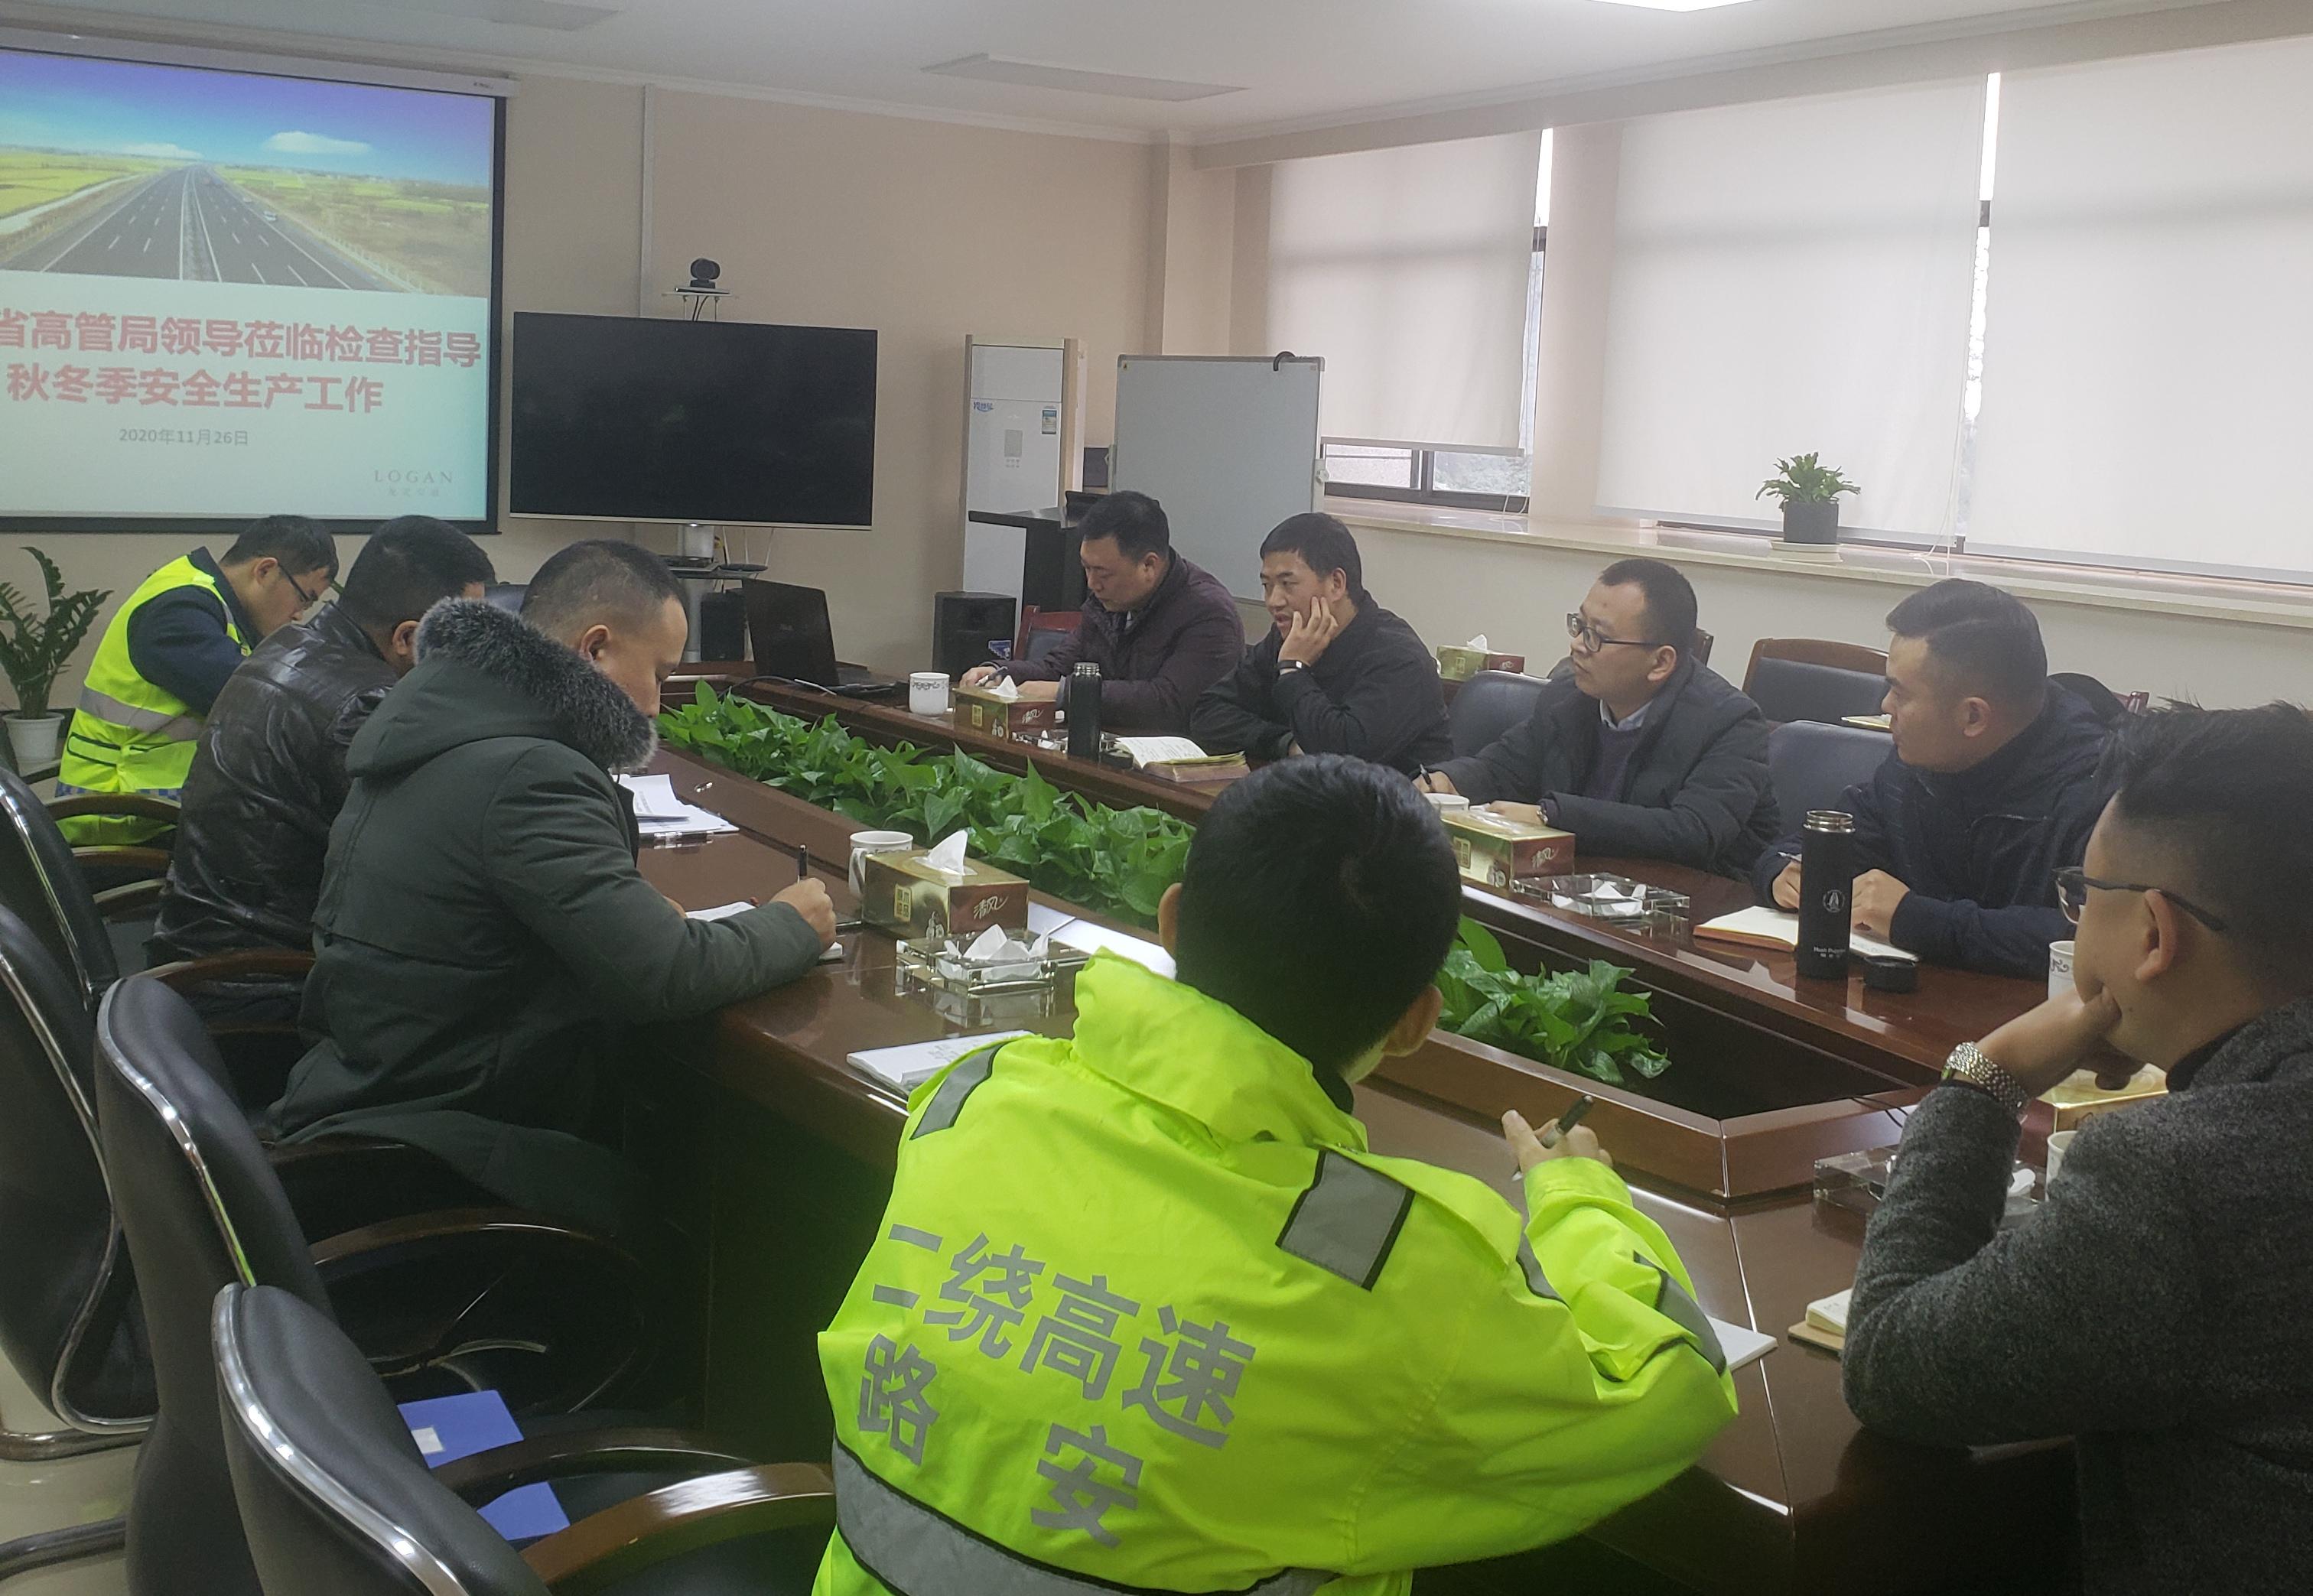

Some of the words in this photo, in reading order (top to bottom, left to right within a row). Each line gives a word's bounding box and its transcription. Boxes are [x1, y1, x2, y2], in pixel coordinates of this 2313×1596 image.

[0, 307, 482, 368] 省高管局领导莅临检查指导
[7, 362, 384, 414] 秋冬季安全生产工作
[119, 428, 249, 446] 2020年11月26日
[374, 469, 454, 484] LOGAN
[973, 895, 1009, 920] 清风
[872, 1223, 1257, 1451] 二绕高速
[857, 1332, 940, 1467] 路
[1030, 1423, 1144, 1550] 安
